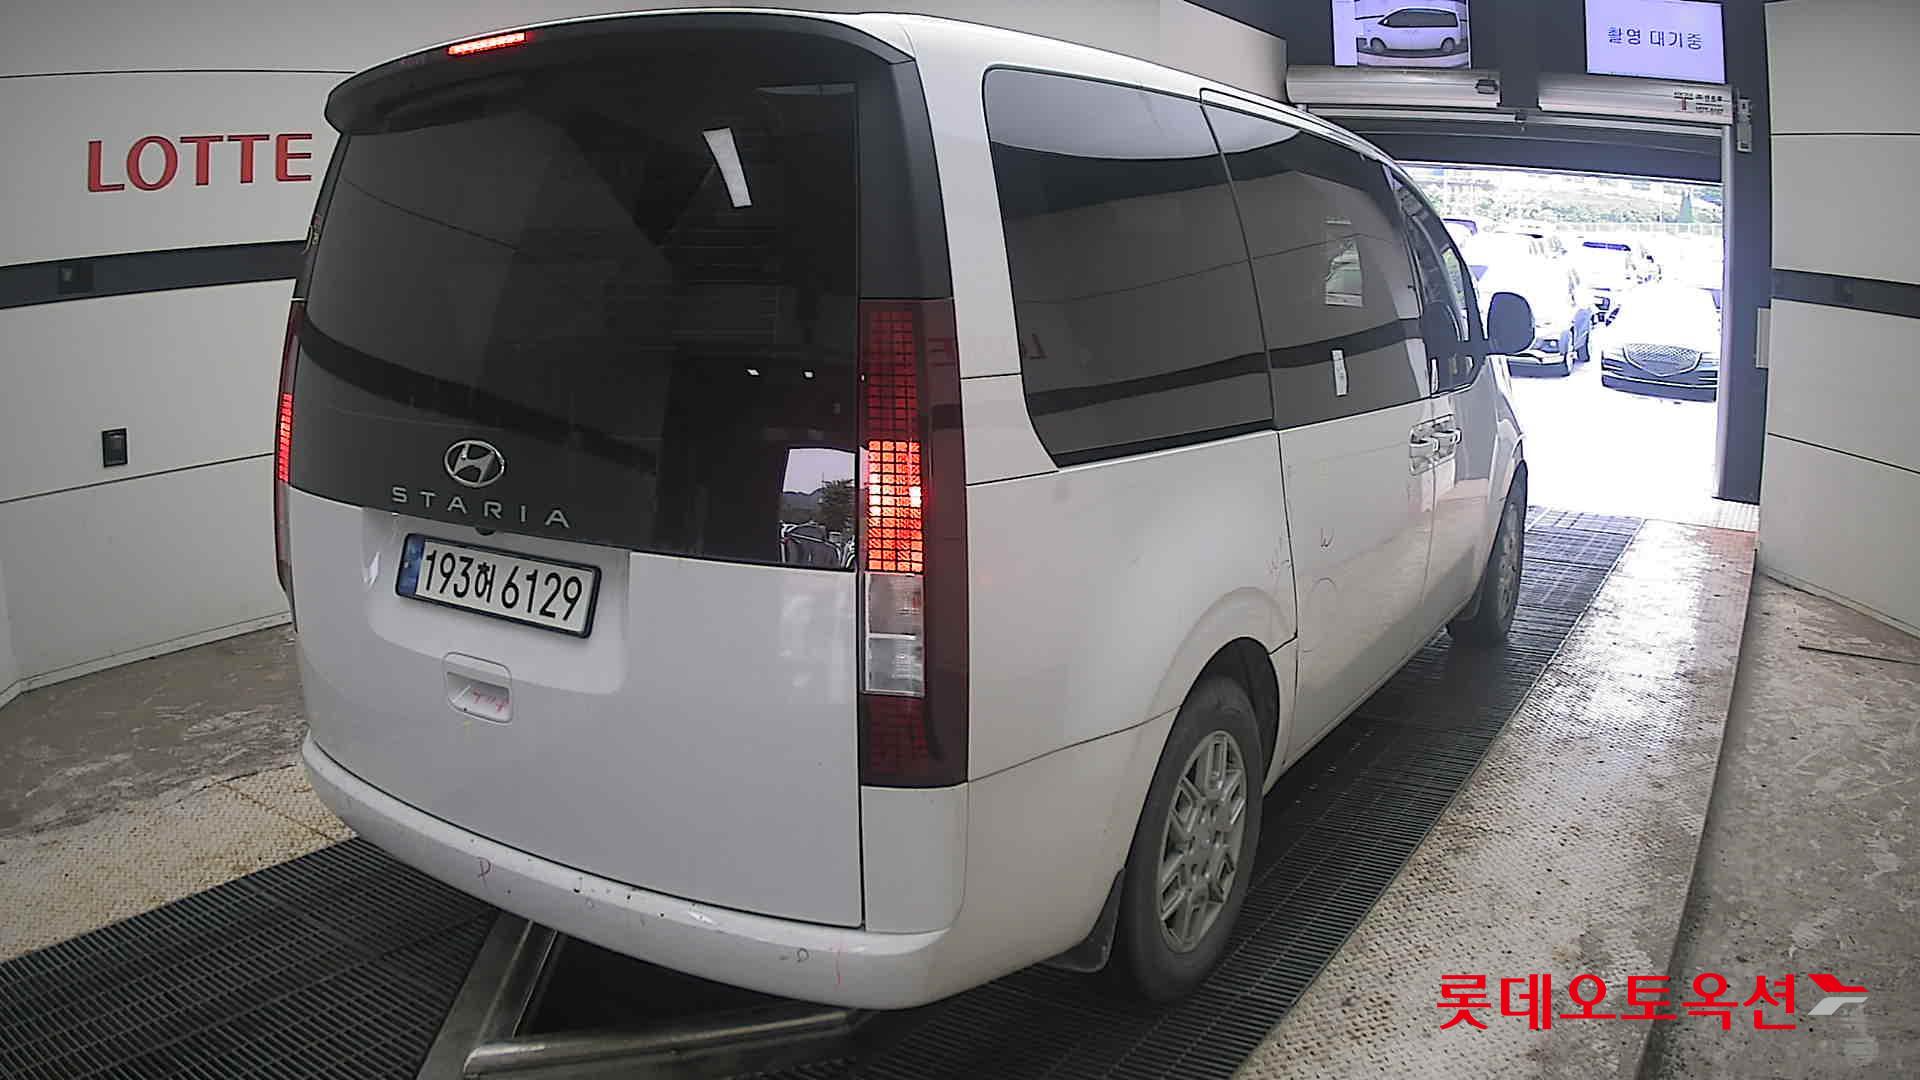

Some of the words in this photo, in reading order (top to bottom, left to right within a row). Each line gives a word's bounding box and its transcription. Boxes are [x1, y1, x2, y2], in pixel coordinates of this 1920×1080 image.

[1650, 31, 1702, 50] 대기중
[88, 133, 312, 192] LOTTE
[392, 486, 570, 528] STARIA
[425, 549, 497, 603] 193허
[501, 565, 583, 621] 6129
